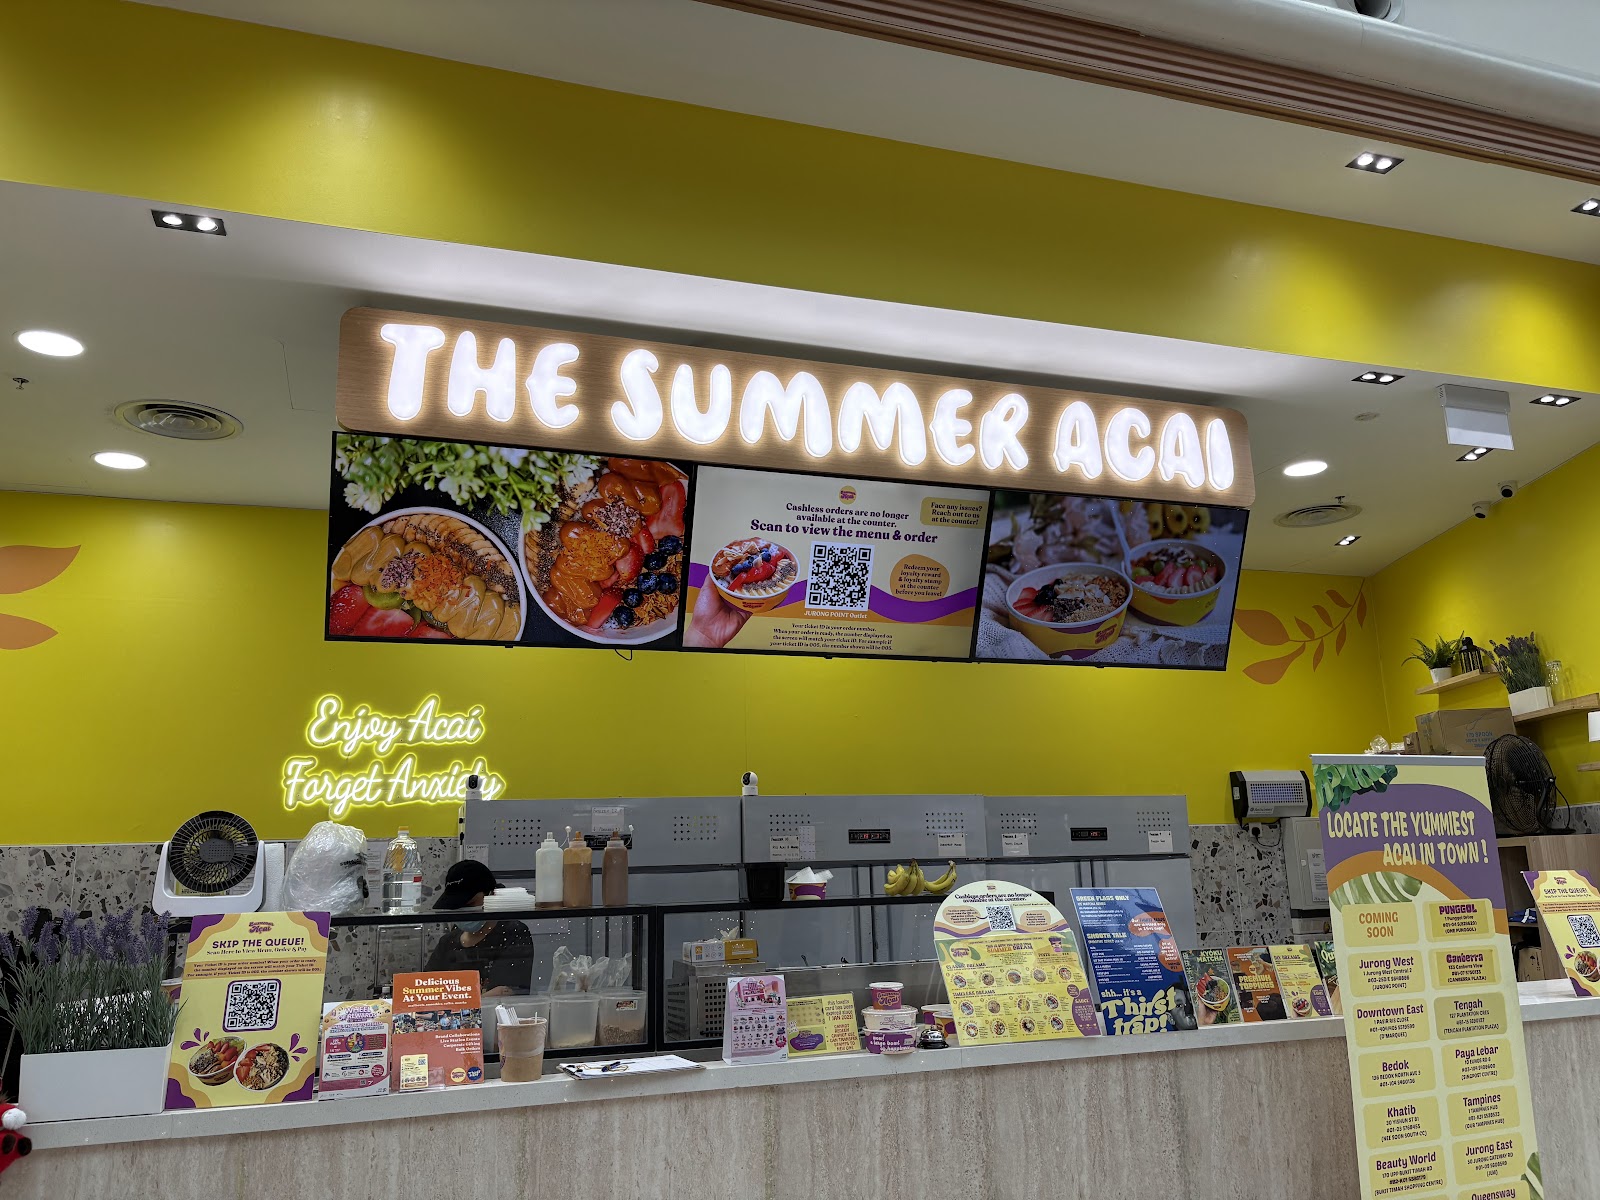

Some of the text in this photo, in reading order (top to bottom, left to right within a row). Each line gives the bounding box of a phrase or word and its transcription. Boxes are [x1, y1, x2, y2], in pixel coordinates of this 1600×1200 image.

[382, 323, 1235, 490] THE SUMMER ACAI
[786, 503, 824, 512] Cashless
[826, 506, 853, 515] orders
[882, 510, 909, 520] longer
[796, 514, 835, 524] available
[862, 520, 896, 528] counter.
[750, 520, 938, 542] Scan to view the menu & order
[310, 698, 401, 752] Enjoy
[287, 760, 382, 815] Forget
[1327, 810, 1474, 838] LOCATE THE YUMMIEST
[1383, 840, 1489, 866] ACAI IN TOWN !
[1439, 904, 1477, 914] PUNGGOL
[1358, 911, 1398, 924] COMING
[1366, 926, 1394, 938] SOON
[212, 938, 304, 948] SKIP THE QUEUE!
[1359, 956, 1414, 969] Jurong West
[415, 978, 460, 986] Delicious
[1239, 982, 1274, 990] TOPPINGS
[402, 986, 444, 994] Summer
[1101, 989, 1122, 998] shh...
[1101, 986, 1176, 1018] Thirst
[1454, 999, 1482, 1011] Tengah
[1357, 1004, 1424, 1019] Downtown East
[1113, 1014, 1168, 1036] trap!
[1456, 1046, 1498, 1060] Paya Lebar
[1382, 1060, 1409, 1072] Bedok
[1462, 1094, 1501, 1106] Tampines
[1388, 1105, 1416, 1118] Khatib
[1466, 1140, 1512, 1156] Jurong East
[1376, 1152, 1436, 1170] Beauty World
[1472, 1188, 1516, 1200] Queensway
